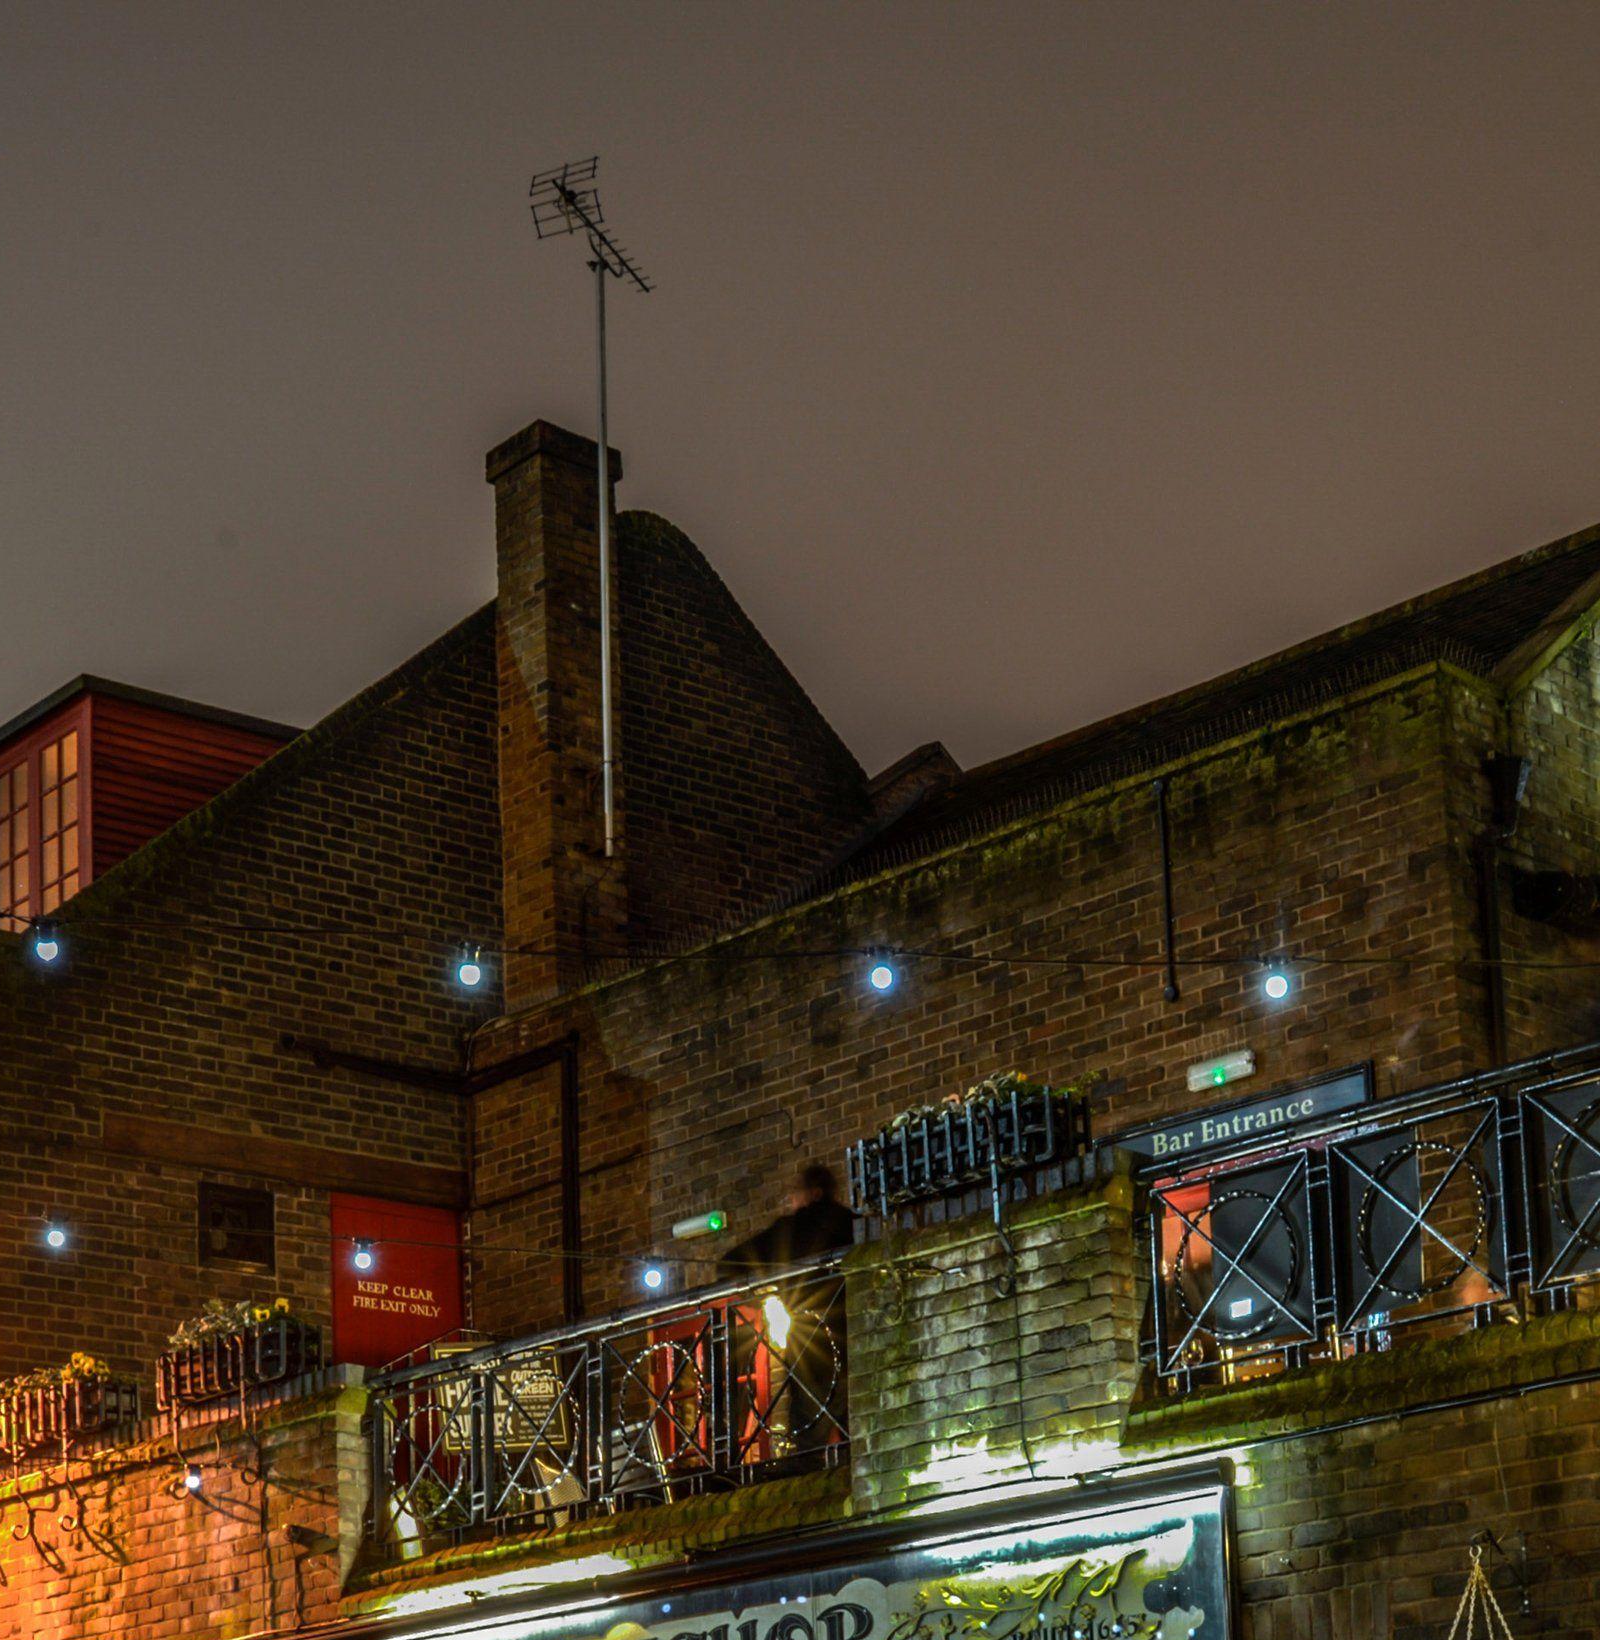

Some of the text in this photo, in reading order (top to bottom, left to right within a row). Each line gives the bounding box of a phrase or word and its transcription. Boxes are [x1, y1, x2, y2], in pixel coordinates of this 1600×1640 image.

[1152, 1098, 1314, 1157] Bar Entrance
[357, 1280, 435, 1302] KEEP CLEAR
[353, 1295, 441, 1318] FIRE EXIT ONLY
[512, 1381, 555, 1396] SREEN
